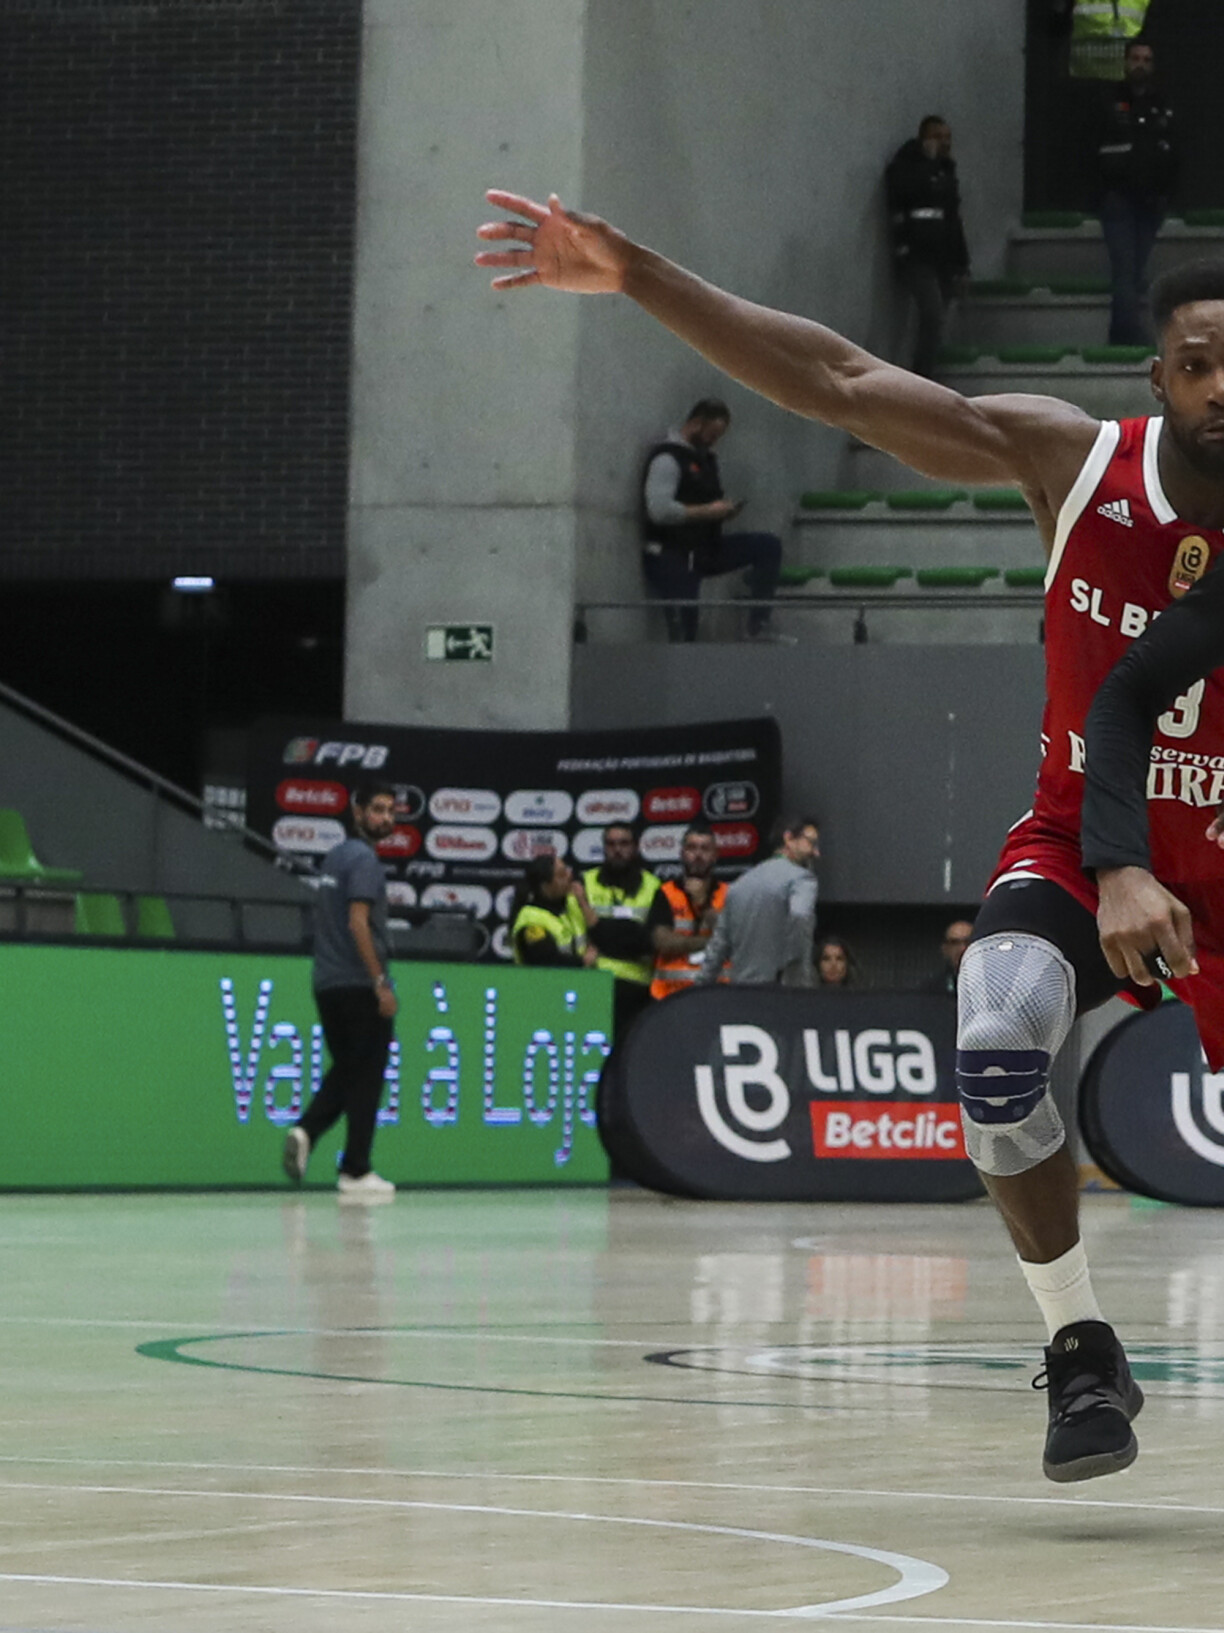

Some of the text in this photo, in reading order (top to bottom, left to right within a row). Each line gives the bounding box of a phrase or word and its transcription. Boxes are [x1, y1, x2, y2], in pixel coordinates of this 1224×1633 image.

[1097, 506, 1133, 527] adidas
[1070, 578, 1110, 626] SL
[314, 741, 390, 768] FPB
[824, 1112, 958, 1149] Betclic
